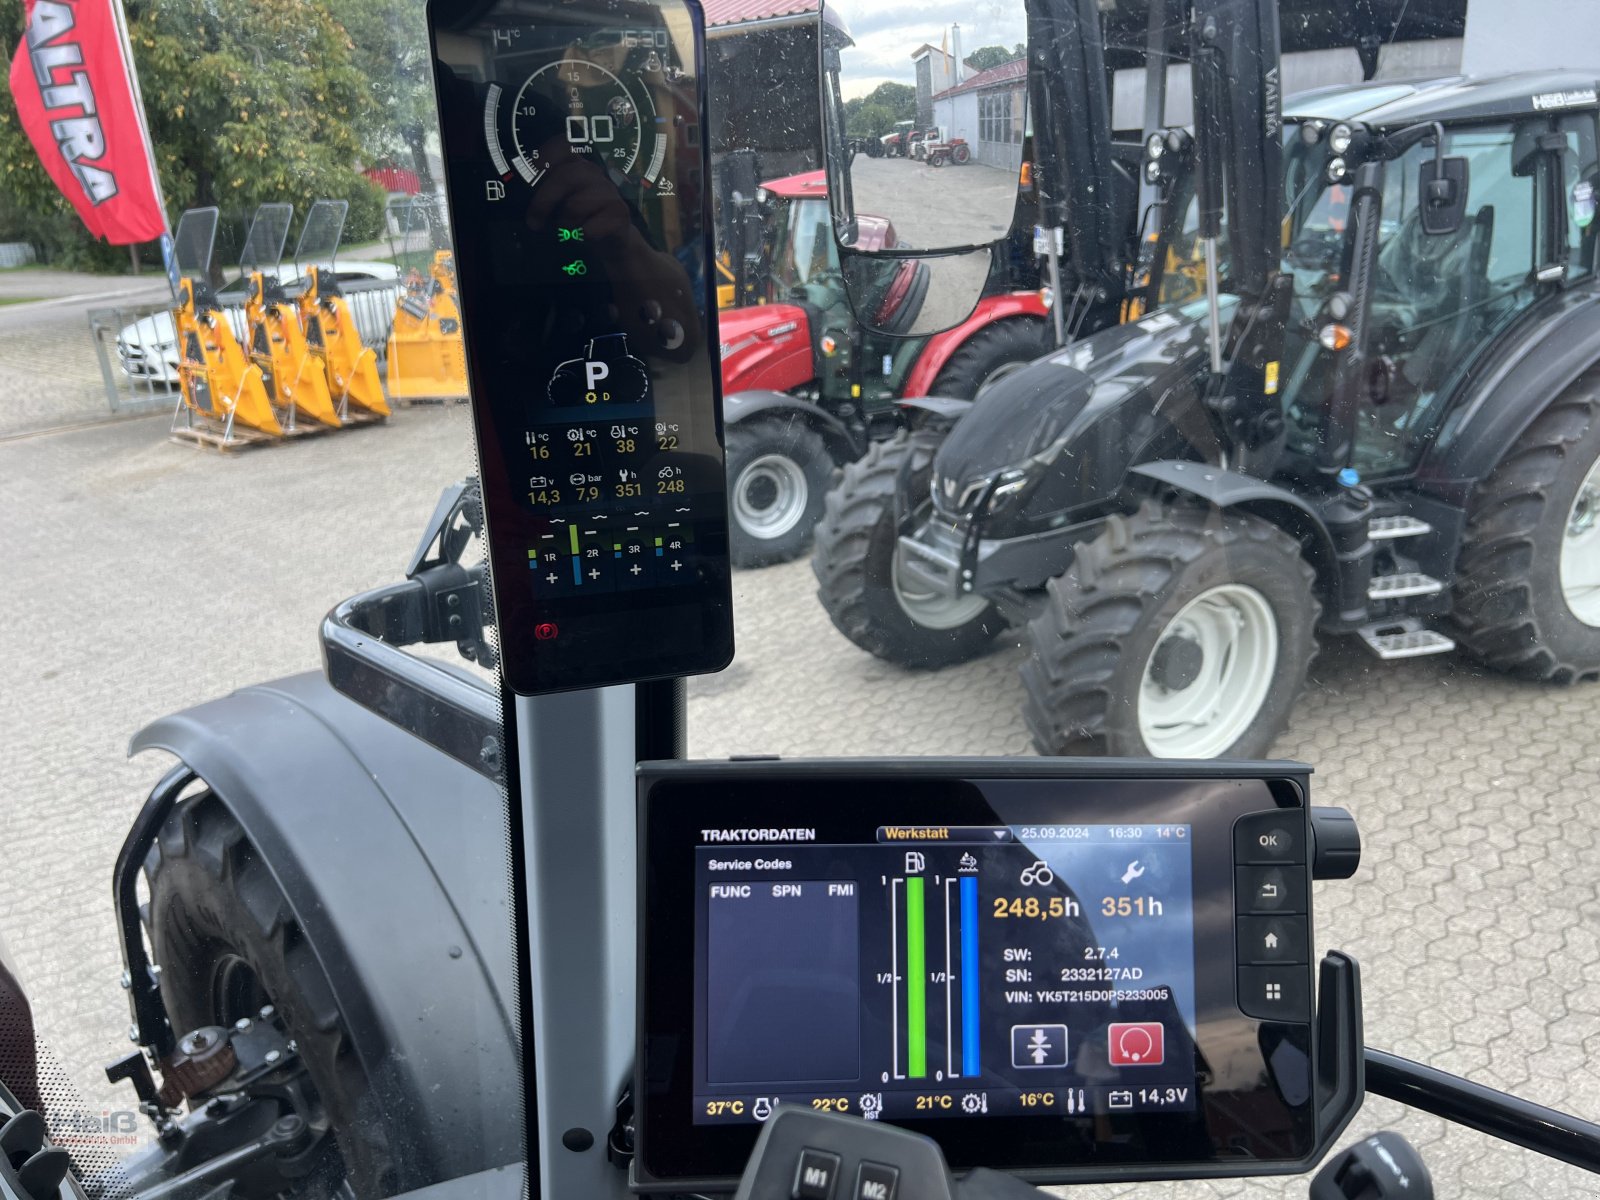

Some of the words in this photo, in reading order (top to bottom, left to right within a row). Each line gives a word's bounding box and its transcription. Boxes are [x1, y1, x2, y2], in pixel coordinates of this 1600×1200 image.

[567, 72, 580, 81] 15
[523, 106, 536, 116] 10
[566, 115, 614, 145] 0.0
[532, 150, 540, 160] 5
[571, 145, 593, 154] km/h
[613, 148, 626, 158] 25
[585, 361, 609, 390] P
[603, 392, 610, 401] D
[616, 439, 636, 453] 38
[659, 436, 678, 450] 22
[529, 446, 550, 460] 16
[573, 442, 592, 457] 21
[630, 471, 637, 479] h
[676, 467, 682, 475] h
[587, 474, 602, 482] bar
[615, 483, 642, 497] 351
[657, 479, 685, 494] 248
[527, 490, 561, 506] 14,3
[575, 486, 599, 502] 7,9
[628, 545, 641, 554] 3R
[669, 541, 682, 550] 4R
[544, 553, 557, 562] 1R
[586, 549, 599, 558] 2R
[701, 828, 815, 842] TRAKTORDATEN
[885, 827, 949, 839] Werkstatt
[1021, 827, 1089, 839] 25.09.2024
[1109, 827, 1142, 838] 16:30
[1259, 835, 1278, 846] OK
[708, 859, 752, 871] Service
[754, 858, 792, 870] Codes
[881, 875, 887, 886] 1
[935, 875, 940, 885] 1
[711, 886, 751, 898] FUNC
[772, 885, 801, 897] SPN
[828, 884, 854, 896] FMI
[993, 896, 1080, 921] 248,5h
[1101, 896, 1163, 917] 351h
[1003, 948, 1032, 961] SW:
[1084, 947, 1119, 960] 2.7.4
[877, 972, 892, 983] 1/2
[931, 972, 946, 983] 1/2
[1005, 970, 1032, 982] SN:
[1060, 967, 1143, 982] 2332127AD
[1005, 991, 1033, 1003] VIN:
[882, 1072, 889, 1083] 0
[936, 1071, 943, 1082] 0
[916, 1095, 952, 1110] 21°C
[1019, 1093, 1055, 1107] 16°C
[1138, 1088, 1189, 1106] 14,3V
[706, 1100, 744, 1115] 37°C
[864, 1110, 880, 1119] HST
[804, 1166, 828, 1188] M1
[863, 1181, 888, 1200] M2
